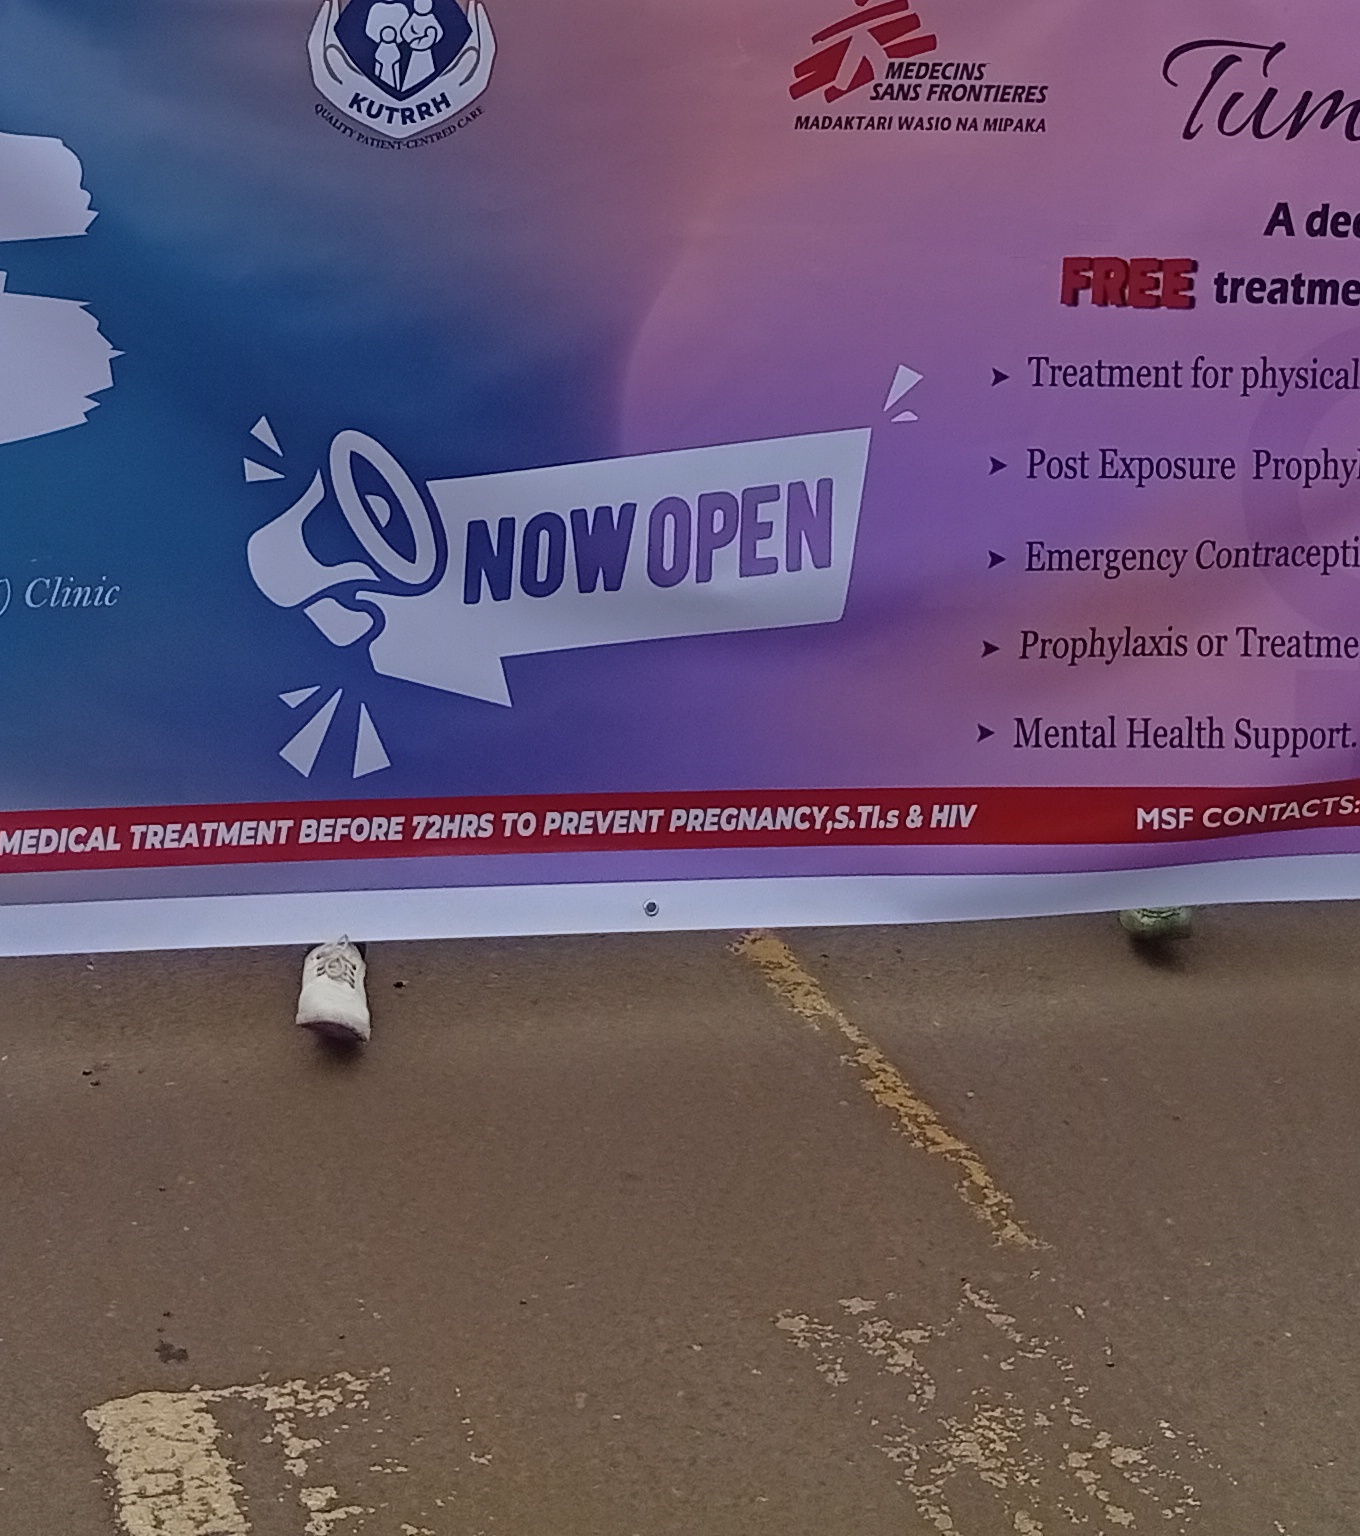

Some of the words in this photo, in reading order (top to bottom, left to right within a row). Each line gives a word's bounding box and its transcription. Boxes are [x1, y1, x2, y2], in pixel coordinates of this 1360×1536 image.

[885, 62, 987, 81] MEDECINS
[348, 92, 451, 125] KUTRRH
[870, 83, 920, 101] SANS
[926, 84, 1048, 103] FRONTIERES
[794, 115, 891, 130] MADAKTARI
[898, 116, 951, 132] WASIO
[956, 117, 978, 132] NA
[983, 117, 1046, 133] MIPAKA
[1264, 202, 1296, 238] A
[1060, 256, 1199, 310] FREE
[1028, 356, 1183, 389] Treatment
[1190, 356, 1233, 389] for
[1241, 356, 1360, 397] physical
[1027, 448, 1090, 480] Post
[1099, 448, 1236, 488] Exposure
[463, 502, 637, 605] NOW
[647, 477, 833, 589] OPEN
[1025, 541, 1188, 579] Emergency
[25, 574, 121, 610] Clinic
[1019, 626, 1188, 666] Prophylaxis
[1196, 635, 1228, 657] or
[1013, 716, 1117, 749] Mental
[1126, 716, 1226, 749] Health
[1234, 718, 1358, 758] Support.
[130, 818, 294, 850] TREATMENT
[298, 816, 403, 843] BEFORE
[411, 813, 493, 840] 72HRS
[501, 812, 537, 837] TO
[543, 808, 664, 836] PREVENT
[906, 804, 924, 828] &
[930, 804, 978, 829] HIV
[1136, 807, 1194, 830] MSF
[1202, 794, 1360, 829] CONTACTS:
